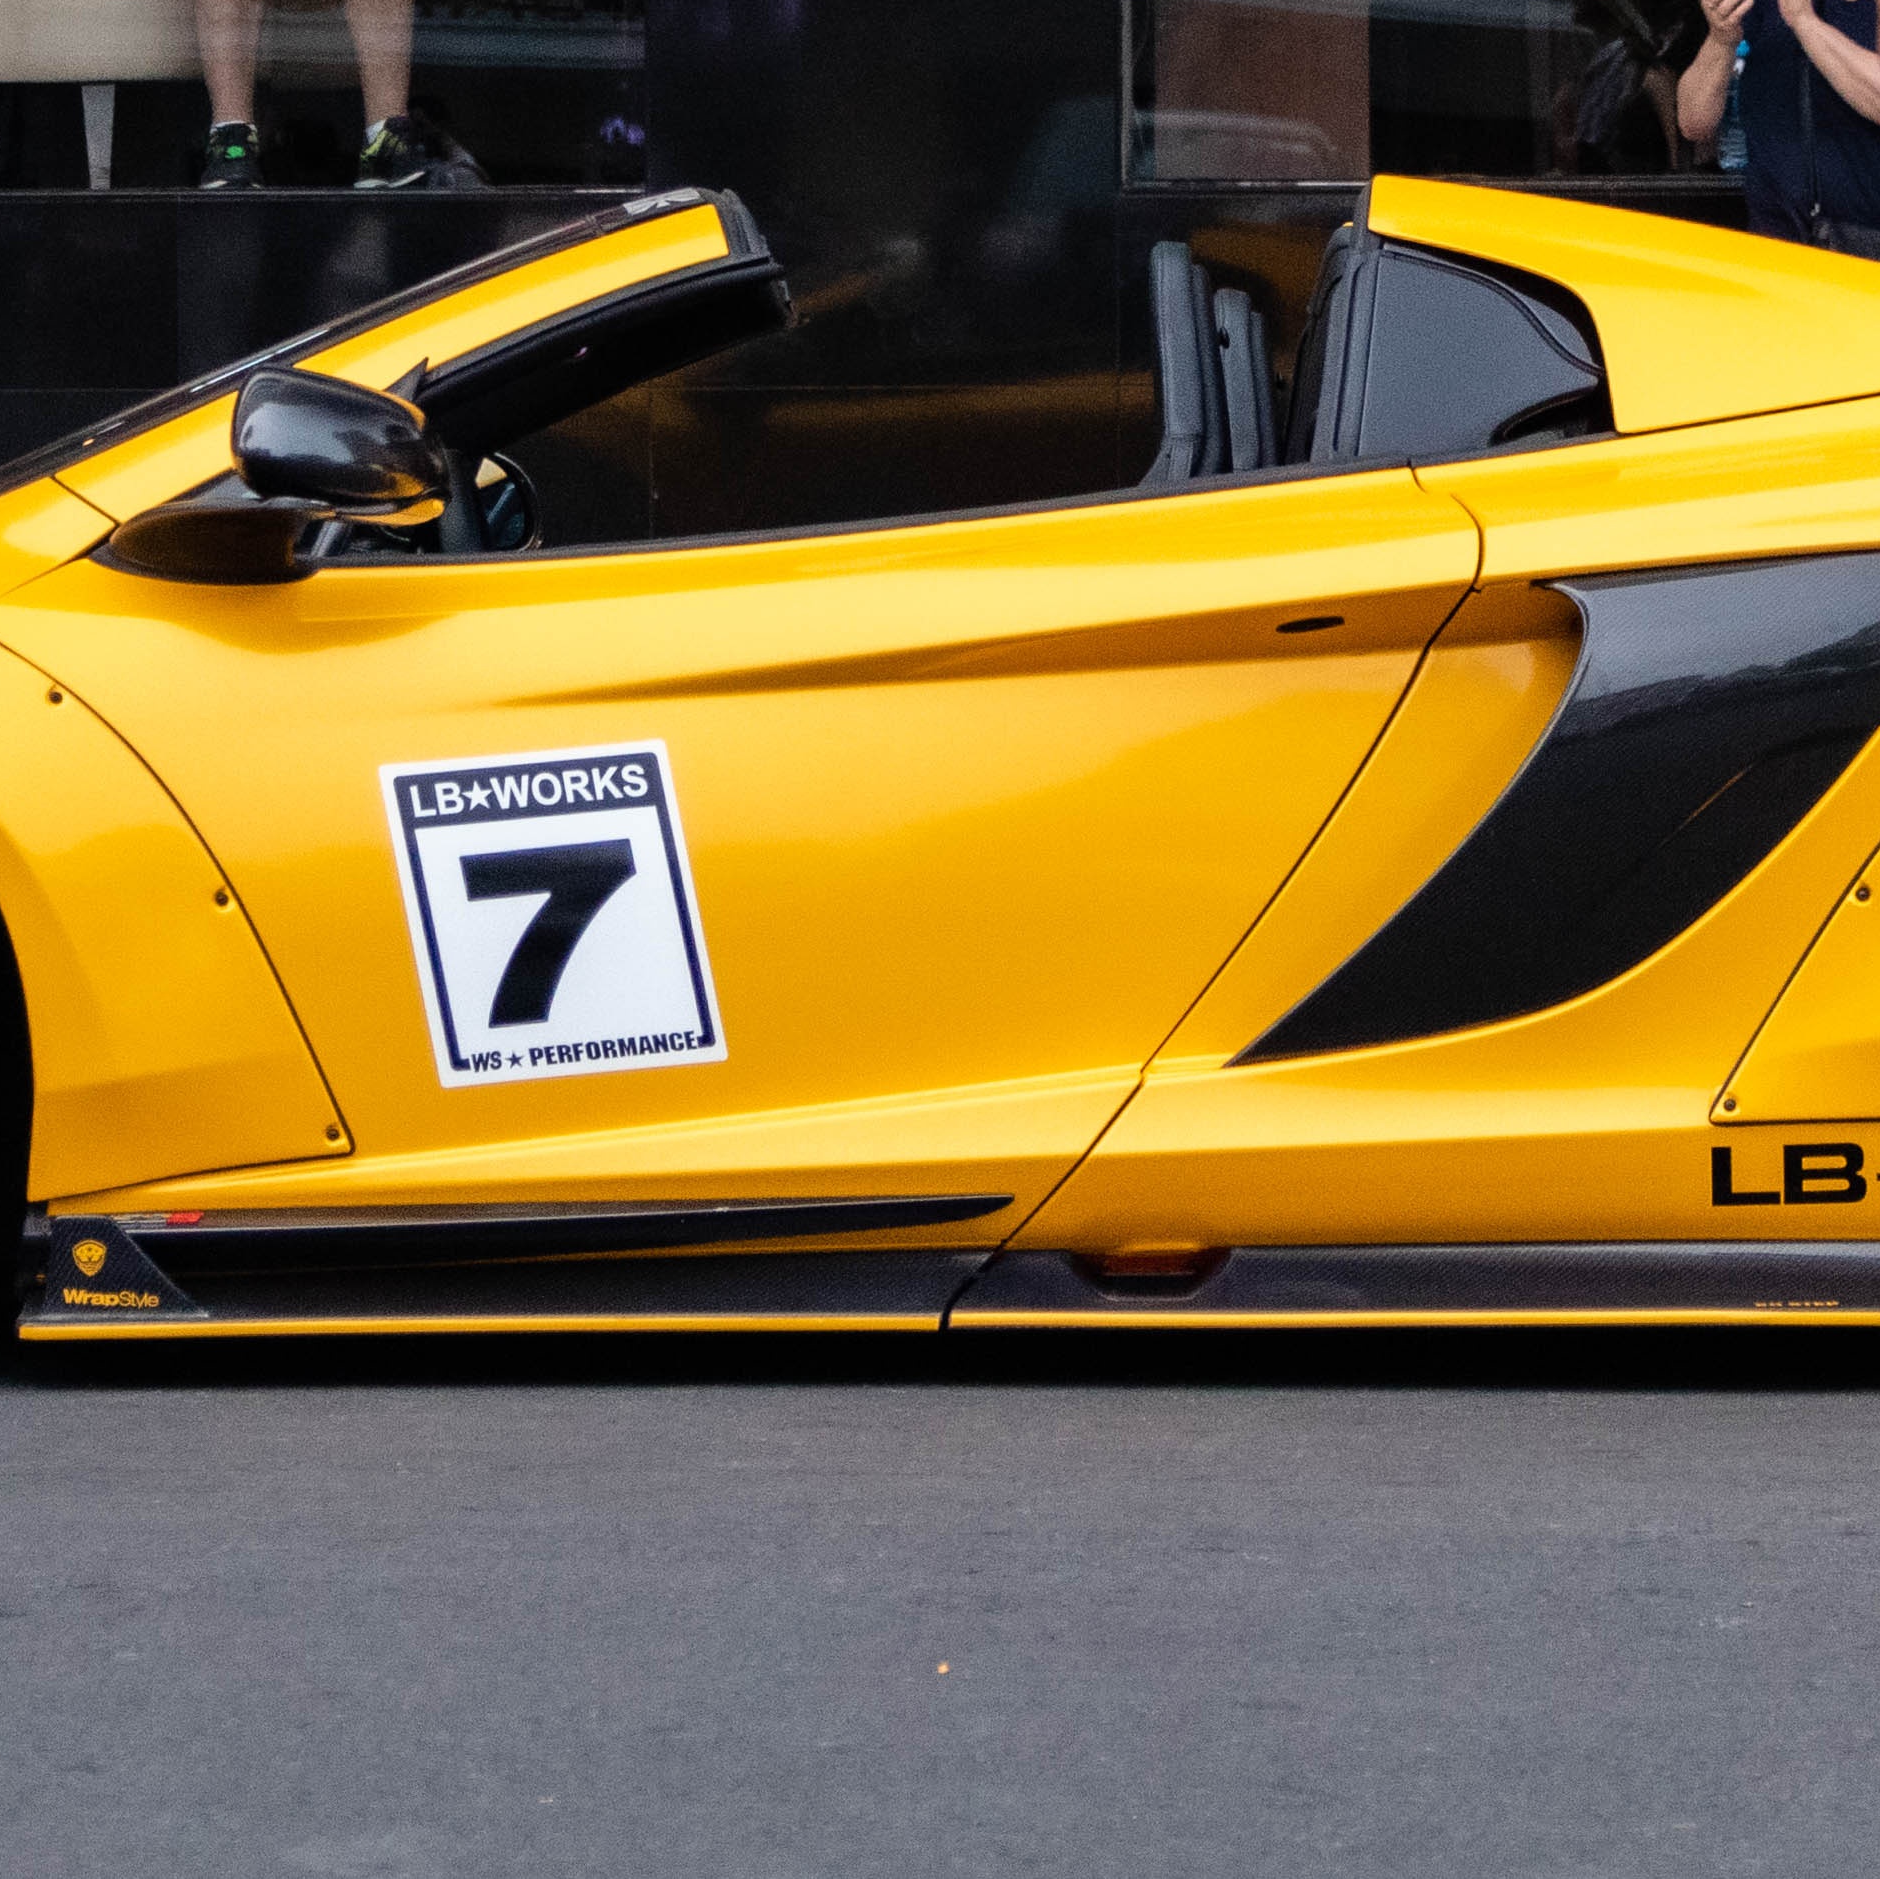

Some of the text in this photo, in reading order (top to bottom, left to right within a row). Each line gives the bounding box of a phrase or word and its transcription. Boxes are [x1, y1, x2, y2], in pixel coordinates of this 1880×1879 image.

[459, 837, 638, 1030] 7
[471, 1030, 700, 1073] WS PERFORMANCE
[62, 1288, 160, 1310] WrapStyle
